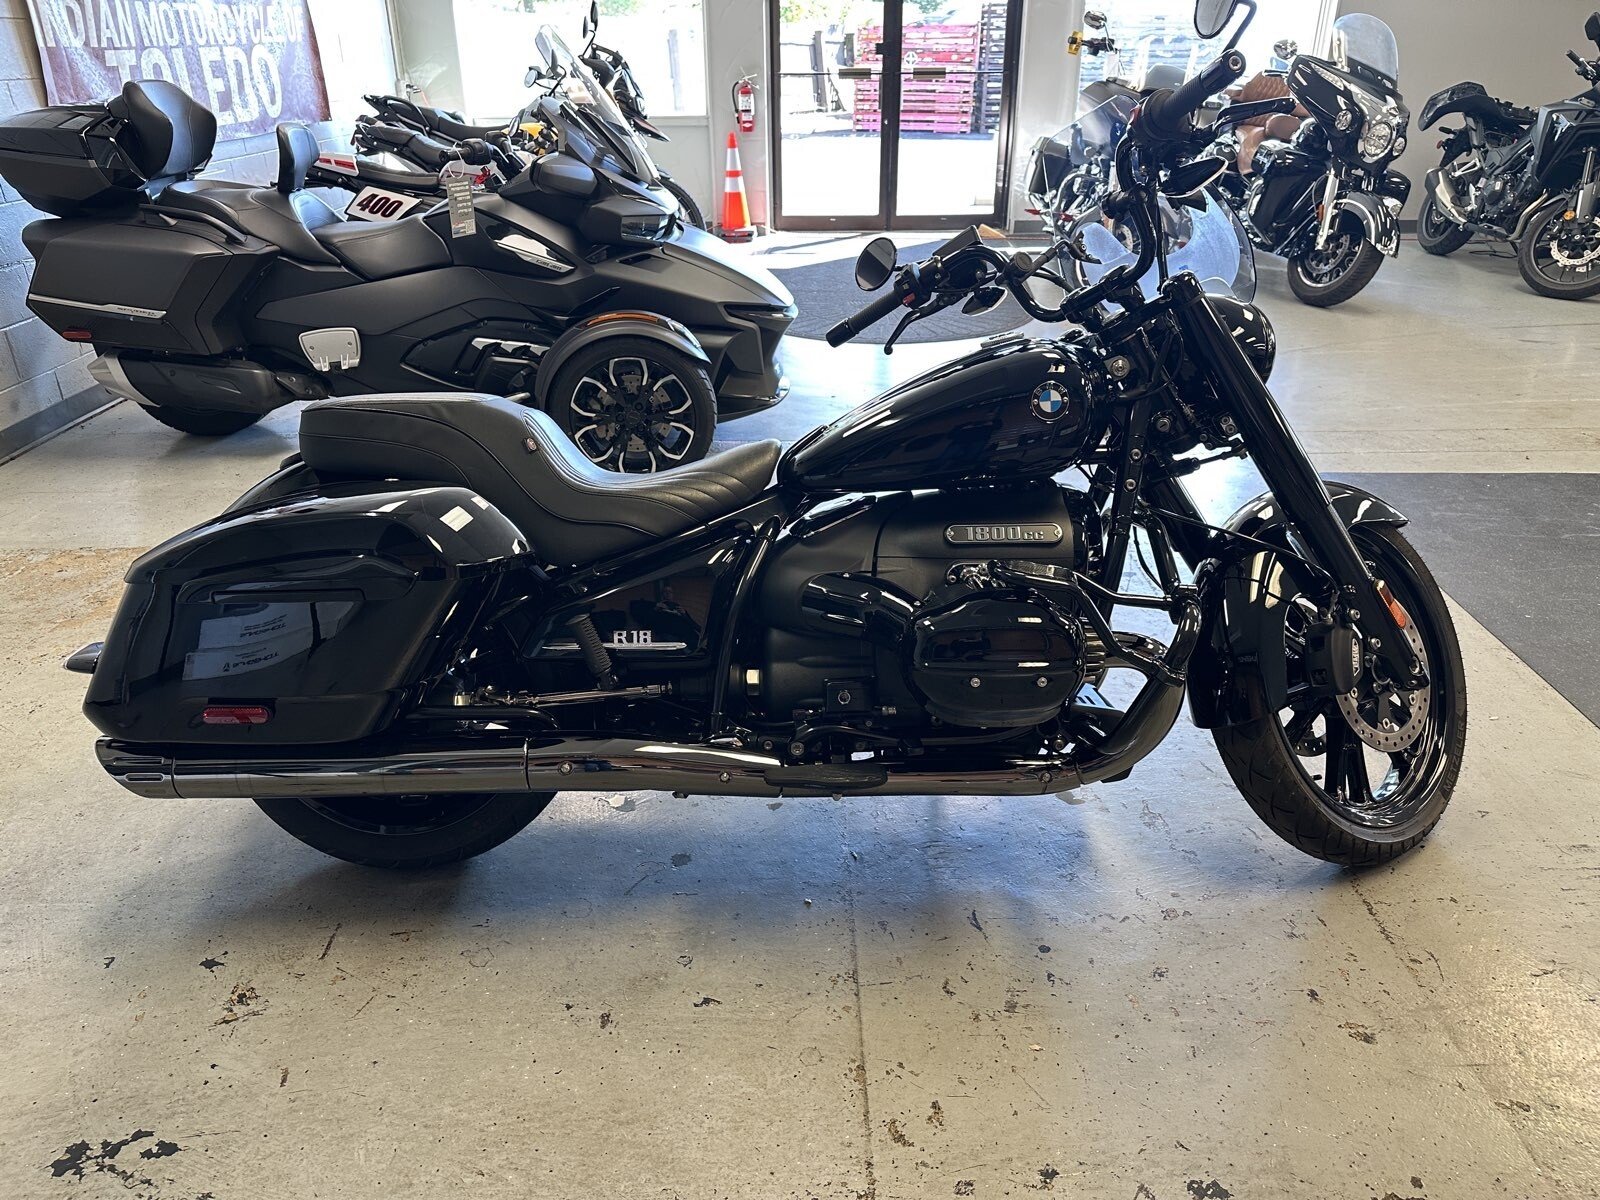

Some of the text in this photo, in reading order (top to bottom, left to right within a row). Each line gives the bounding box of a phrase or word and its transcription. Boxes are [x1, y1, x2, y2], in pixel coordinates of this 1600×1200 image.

[27, 0, 136, 47] INDIAN
[135, 0, 286, 47] MOTORCYCLE
[356, 193, 404, 218] 400
[1443, 721, 1466, 791] METZELER
